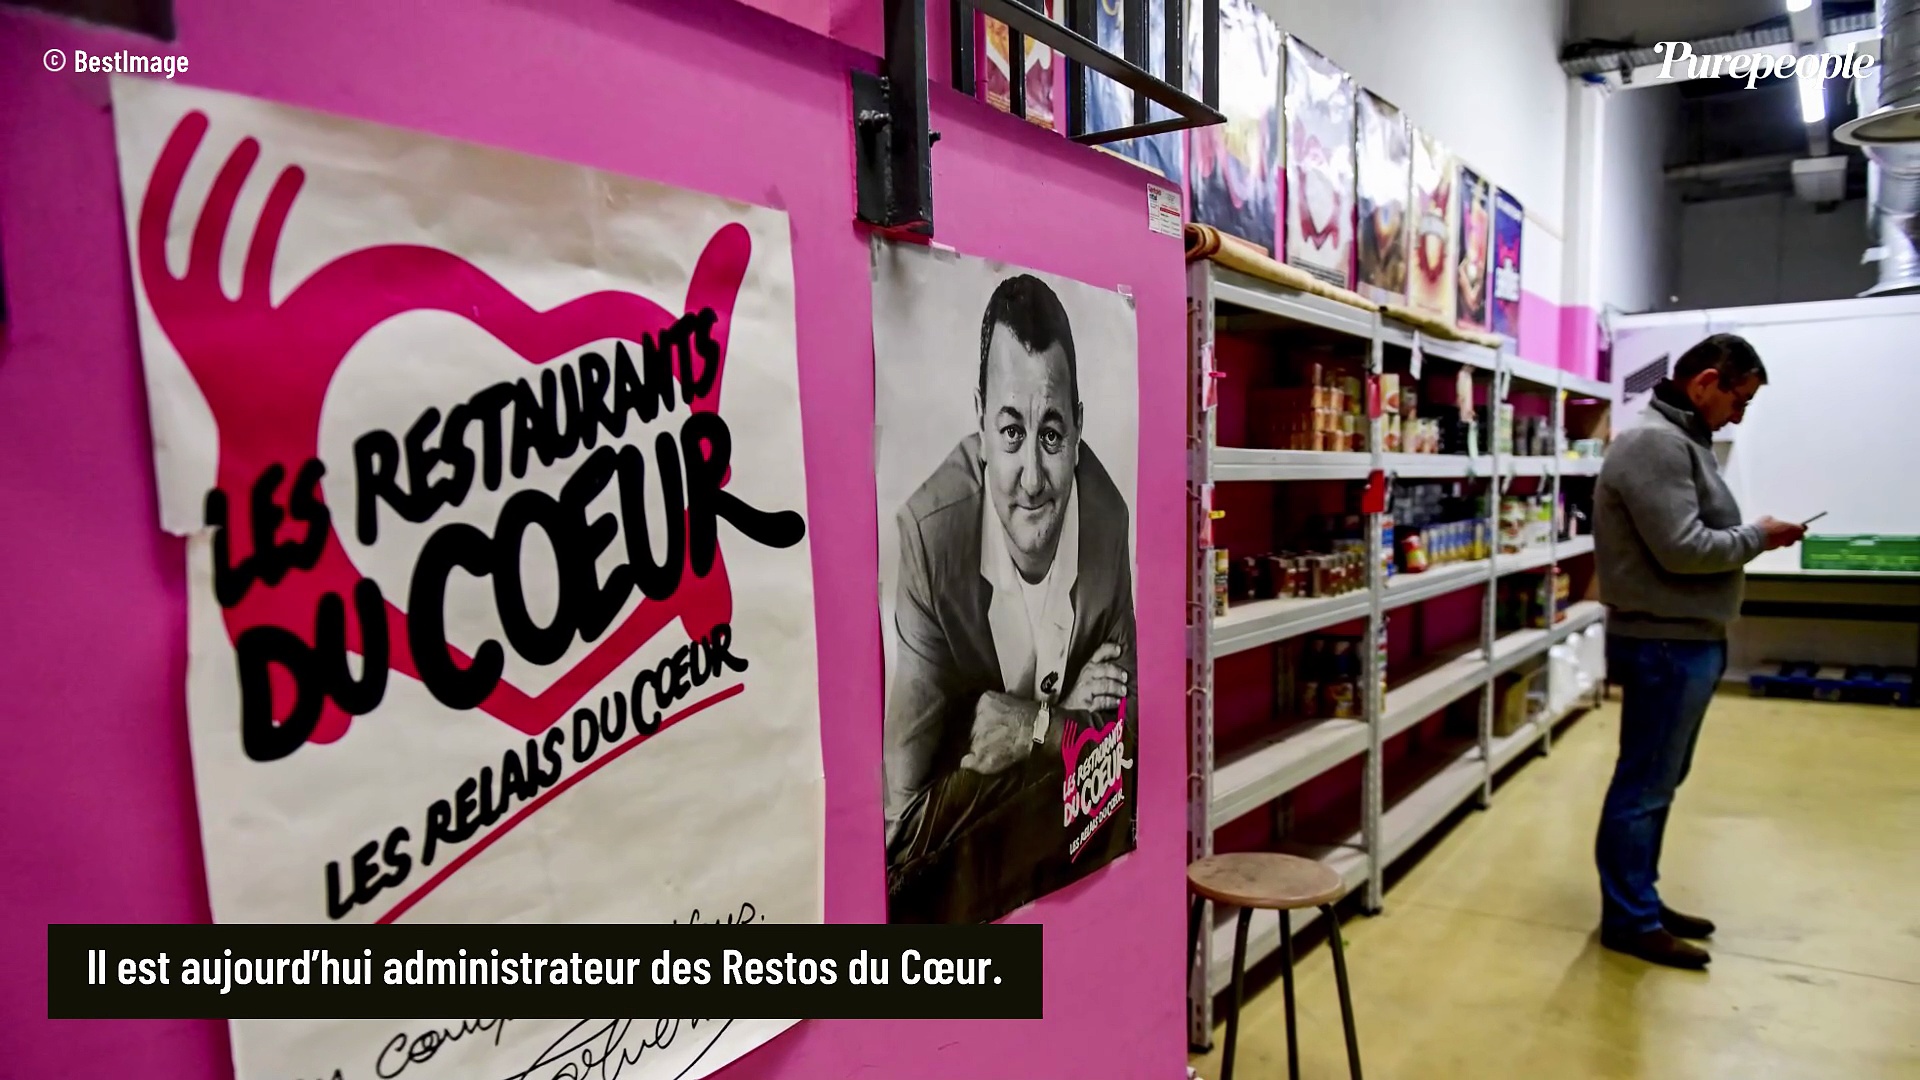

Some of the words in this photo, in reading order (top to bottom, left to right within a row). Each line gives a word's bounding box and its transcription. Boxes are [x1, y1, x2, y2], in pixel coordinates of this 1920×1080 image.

[205, 457, 331, 608] LES
[353, 307, 720, 546] RESTAURANTS
[235, 577, 390, 763] DU
[1063, 772, 1076, 802] LES
[1077, 719, 1124, 787] RESTAURANTS
[326, 826, 412, 920] LES
[421, 727, 565, 867] RELAIS
[572, 691, 627, 763] DU
[1064, 791, 1080, 828] DU
